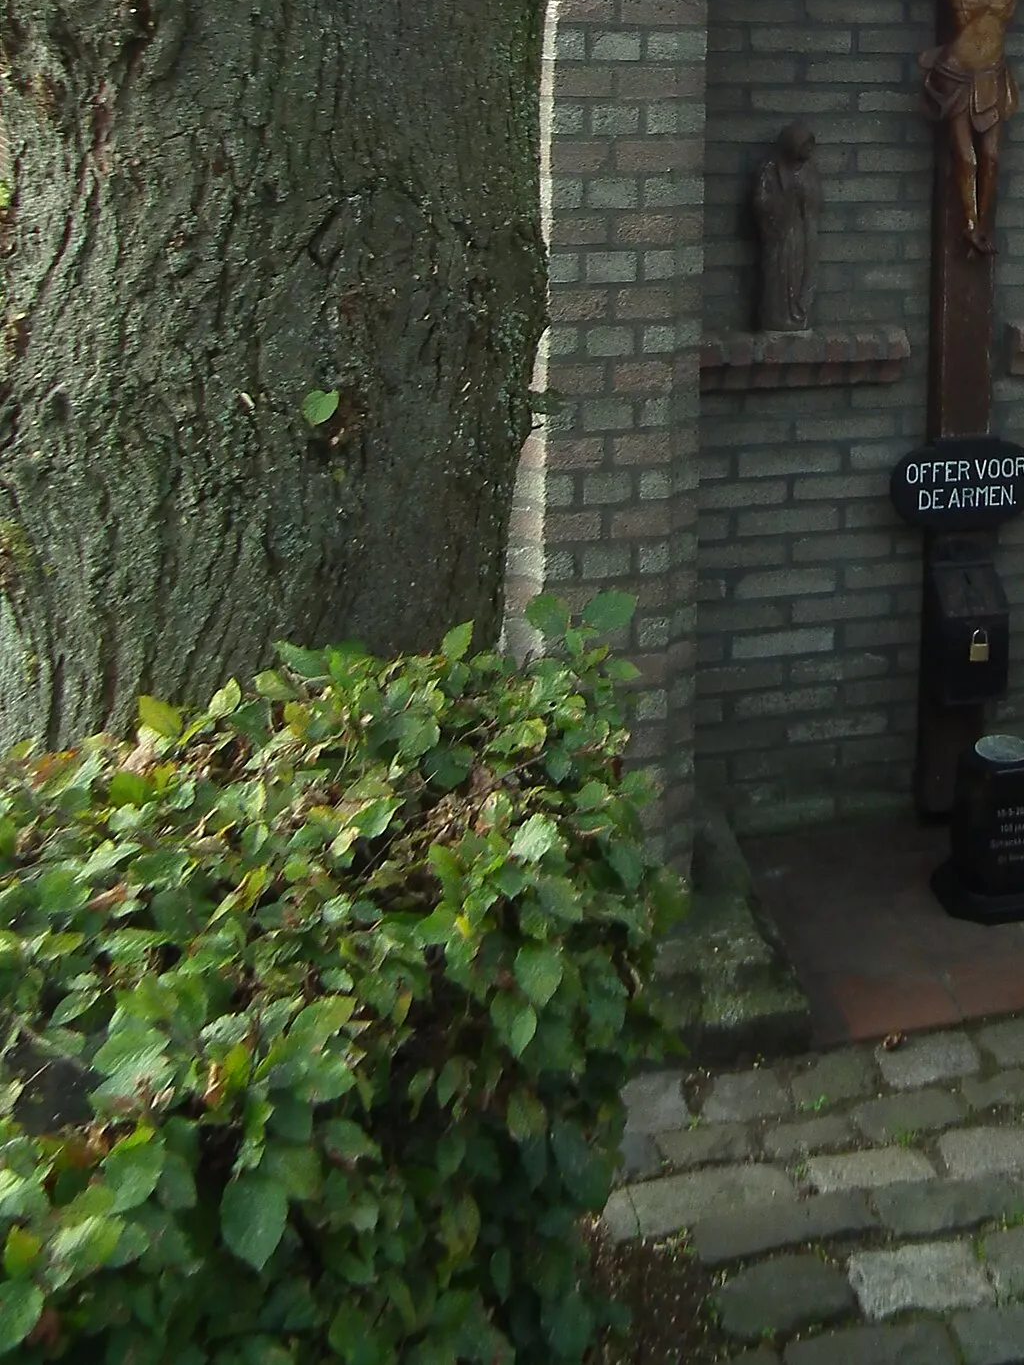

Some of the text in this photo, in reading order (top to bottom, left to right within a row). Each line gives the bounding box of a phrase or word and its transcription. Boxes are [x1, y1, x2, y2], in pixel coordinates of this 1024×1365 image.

[906, 460, 971, 484] OFFER
[918, 484, 1017, 510] DE ARMEN.
